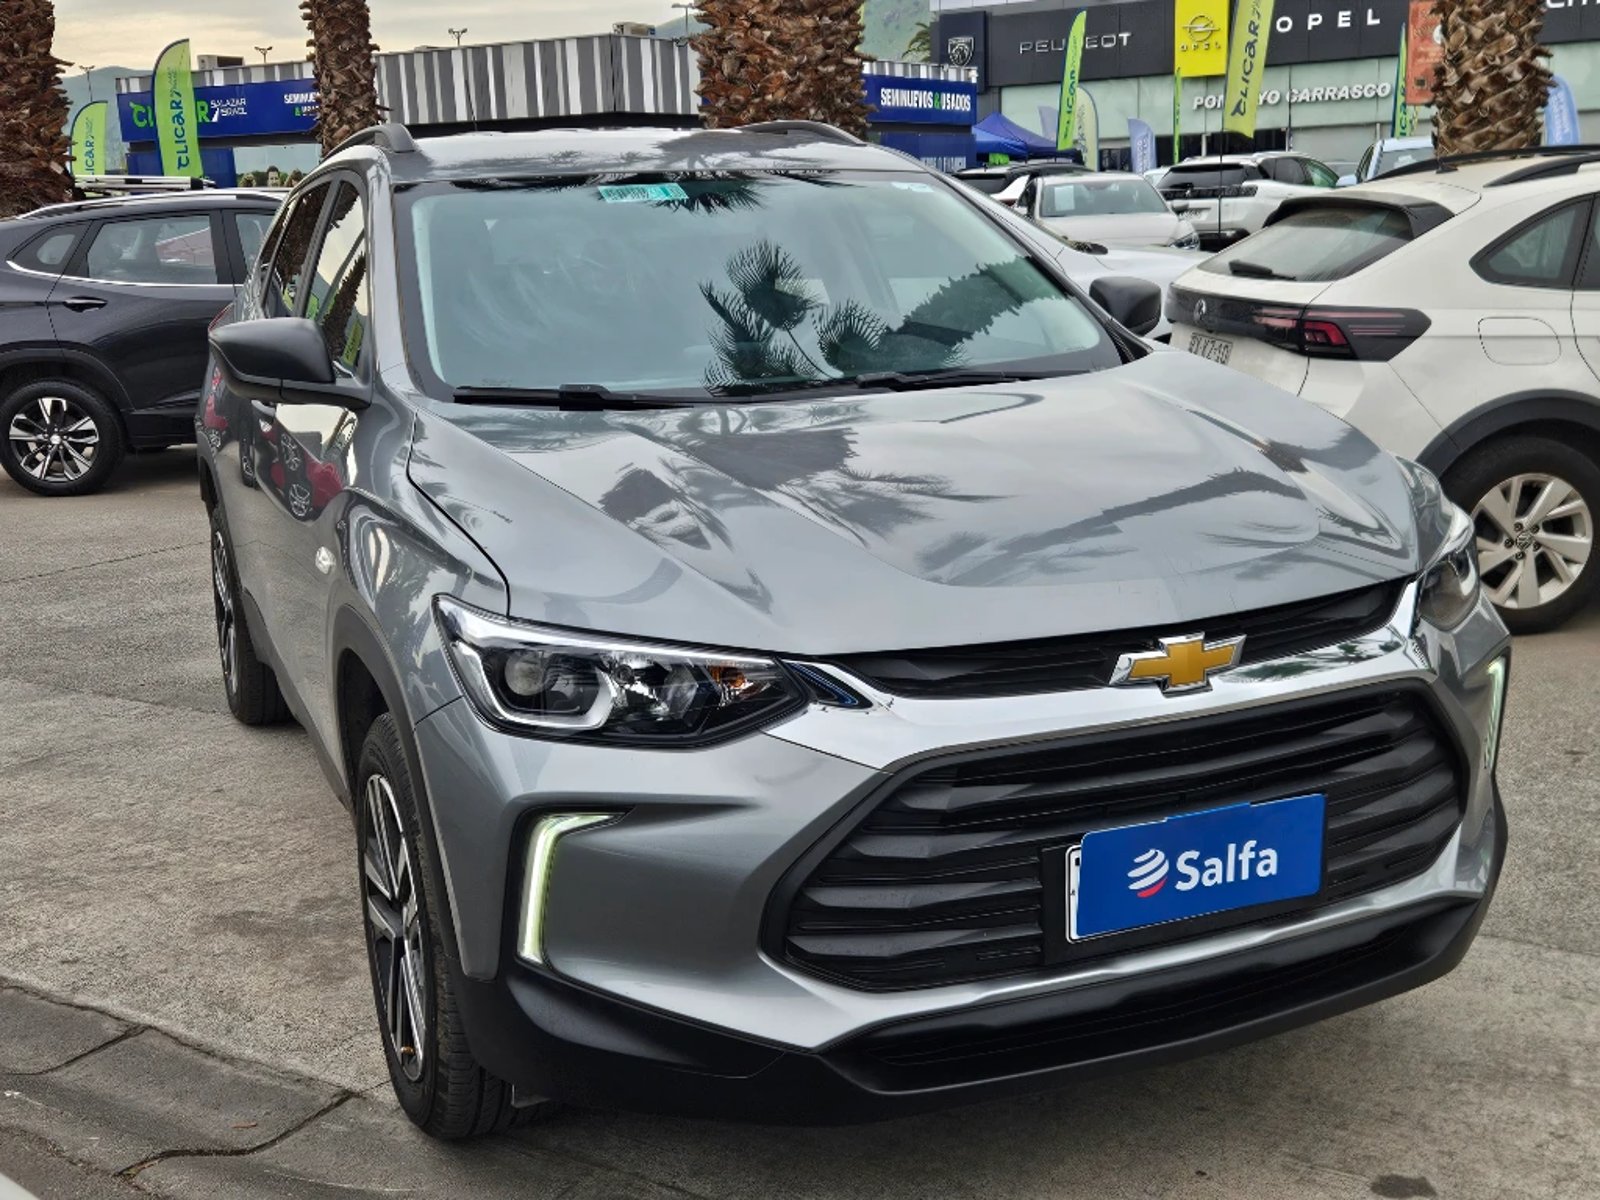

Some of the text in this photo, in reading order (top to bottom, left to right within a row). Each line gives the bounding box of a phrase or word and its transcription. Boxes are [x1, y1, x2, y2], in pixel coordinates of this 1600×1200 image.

[1276, 8, 1380, 33] OPEL
[1019, 32, 1132, 54] PEUEOT
[880, 88, 933, 109] SEMINUEVOS
[1286, 82, 1391, 103] CARRASCO
